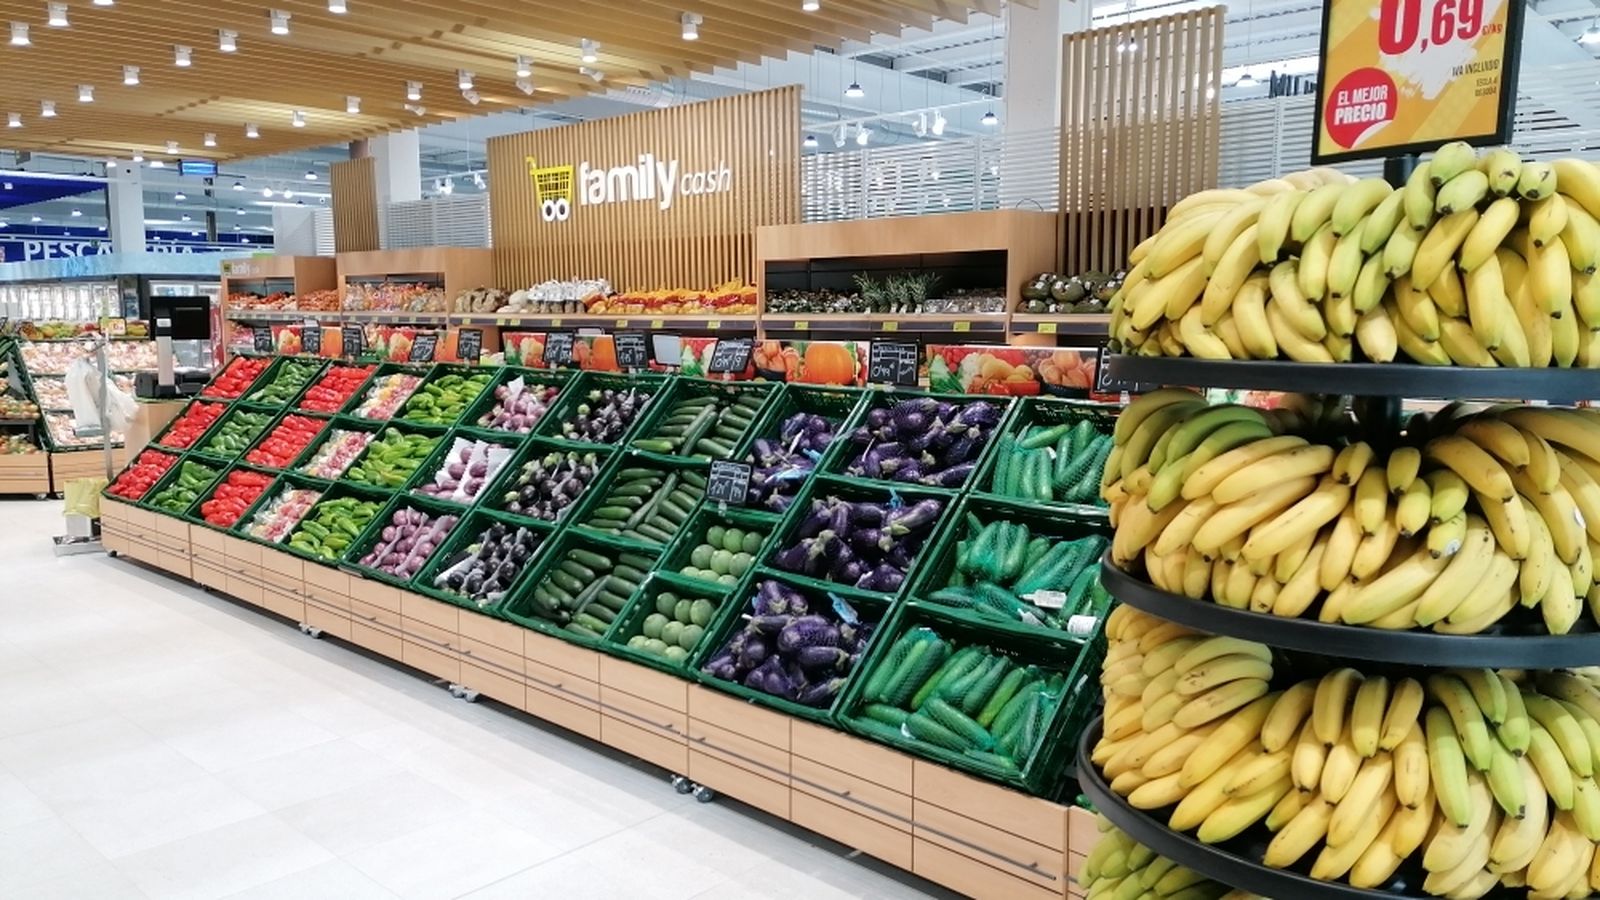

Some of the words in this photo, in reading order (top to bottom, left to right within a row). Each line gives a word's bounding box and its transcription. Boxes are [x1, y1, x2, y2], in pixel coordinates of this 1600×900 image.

[1337, 90, 1350, 106] EL
[1352, 84, 1388, 103] MEJOR
[1334, 102, 1387, 125] PRECIO
[579, 153, 678, 210] family
[680, 160, 731, 195] cash
